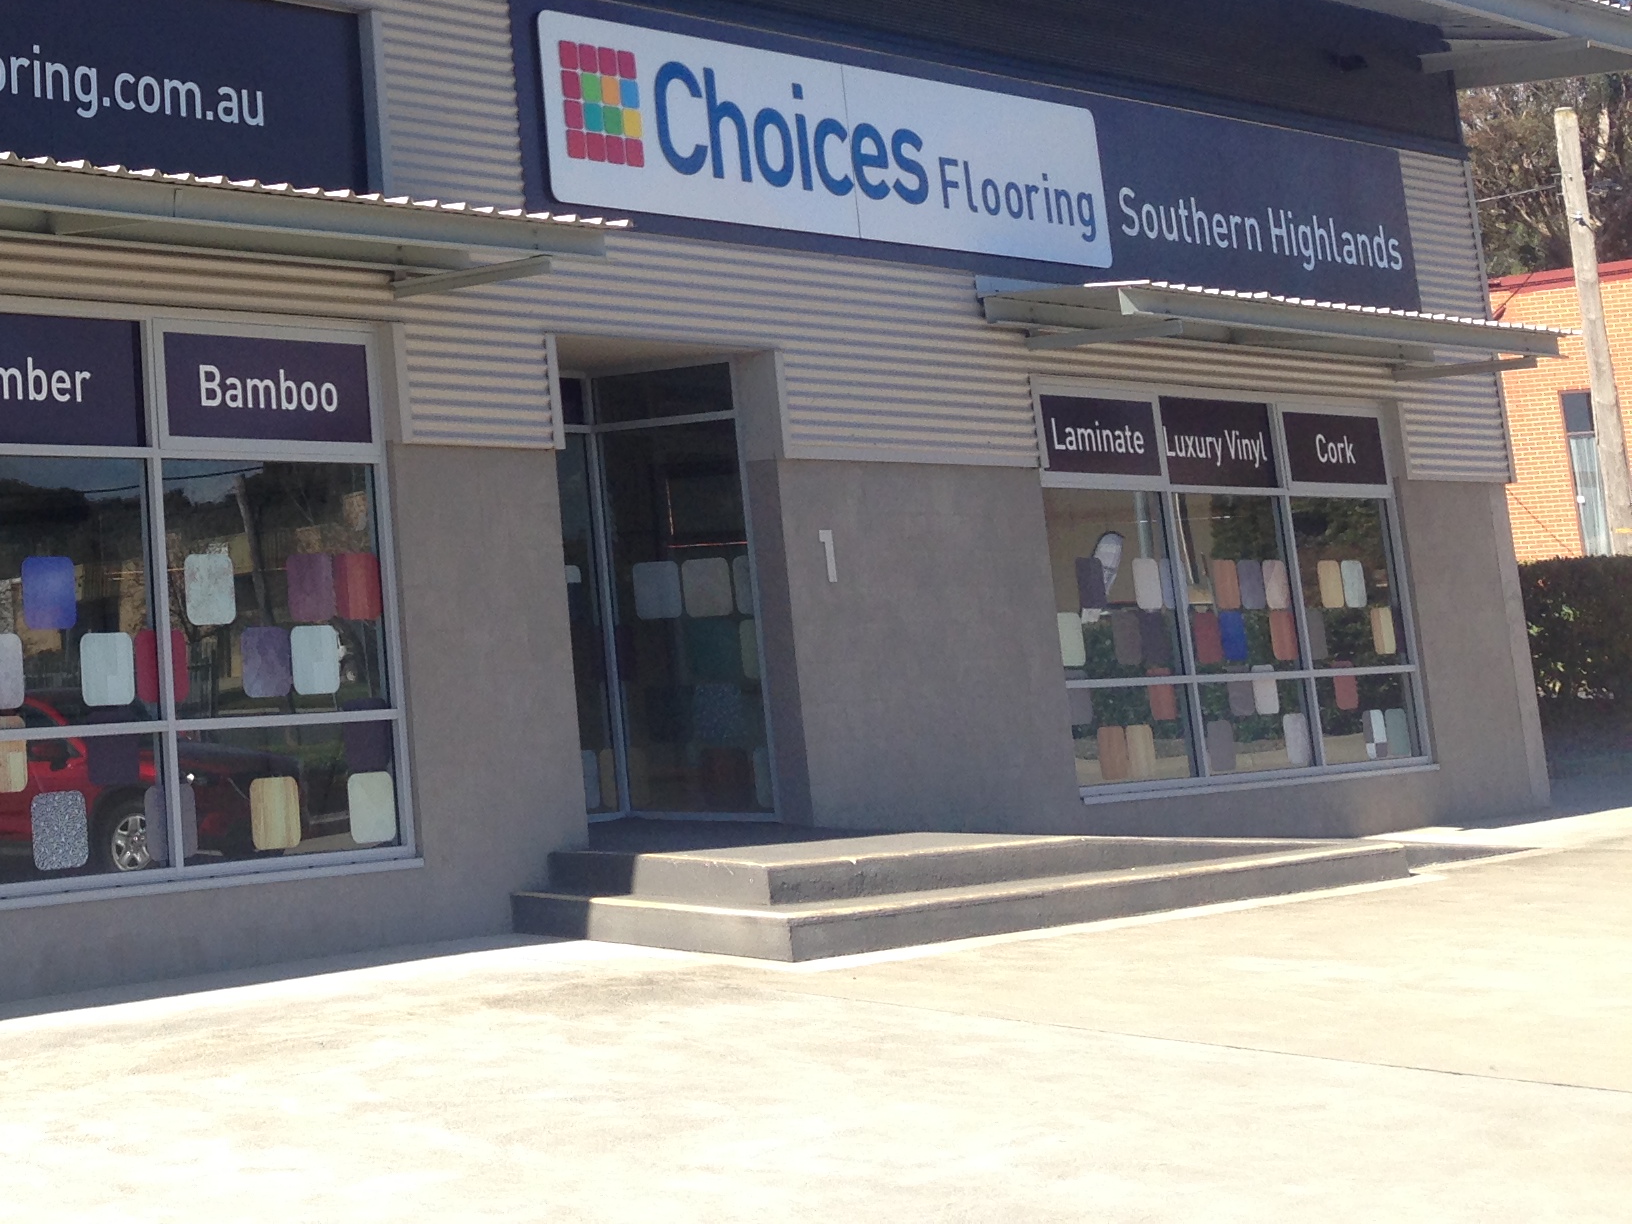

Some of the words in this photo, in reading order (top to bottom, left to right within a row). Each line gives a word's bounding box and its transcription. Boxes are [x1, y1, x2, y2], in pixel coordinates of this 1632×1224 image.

[654, 61, 928, 204] Choices
[939, 156, 1097, 242] Flooring
[1119, 187, 1262, 252] Southern
[1268, 207, 1404, 271] Highlands
[199, 364, 338, 413] Bamboo
[1051, 418, 1145, 455] Laminate
[1163, 426, 1223, 467] Luxury
[1224, 429, 1268, 468] Vinyl
[1315, 433, 1357, 465] Cork
[819, 529, 838, 583] 1
